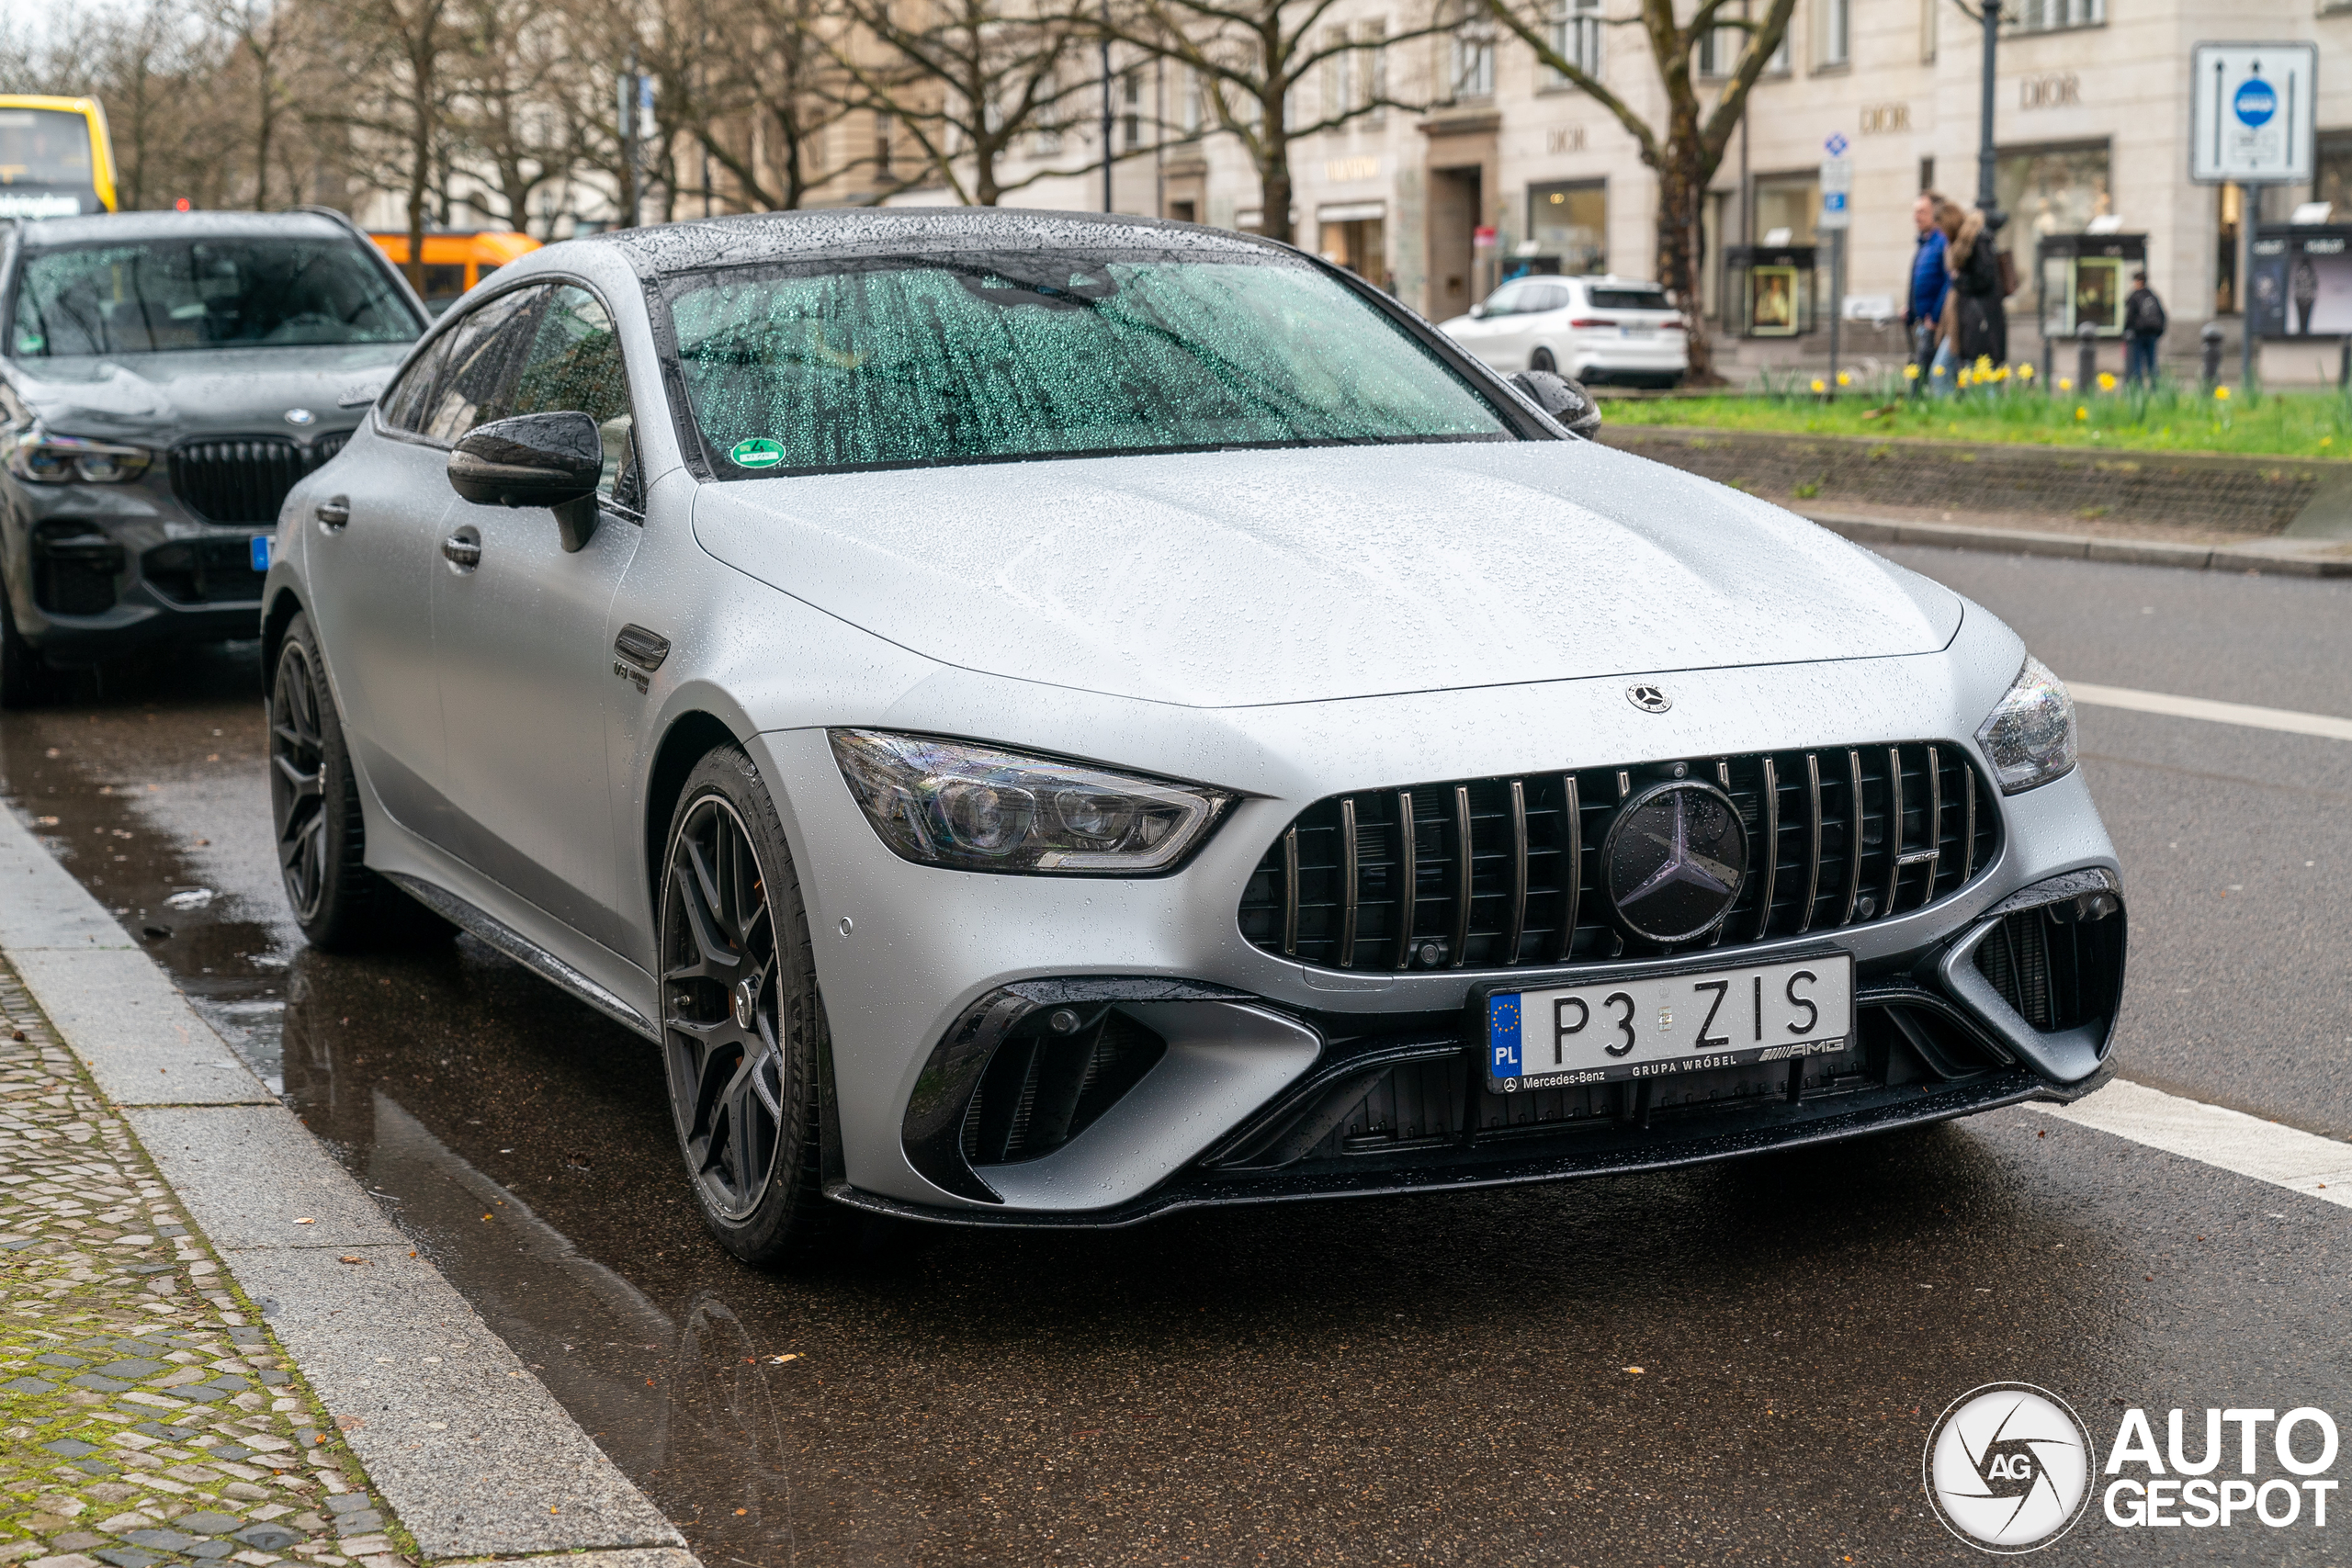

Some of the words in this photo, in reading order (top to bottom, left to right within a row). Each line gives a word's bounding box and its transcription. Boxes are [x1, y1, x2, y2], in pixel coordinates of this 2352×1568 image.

[2021, 73, 2080, 108] DIOR
[1860, 102, 1911, 135] DIOR
[1553, 990, 1636, 1066] P3
[1693, 969, 1819, 1049] ZIS
[1495, 1046, 1518, 1066] PL
[1523, 1071, 1605, 1089] Mercedes-Benz
[1632, 1062, 1677, 1077] GRUPA
[1683, 1055, 1737, 1071] WRÓBEL
[1790, 1038, 1845, 1056] AMG
